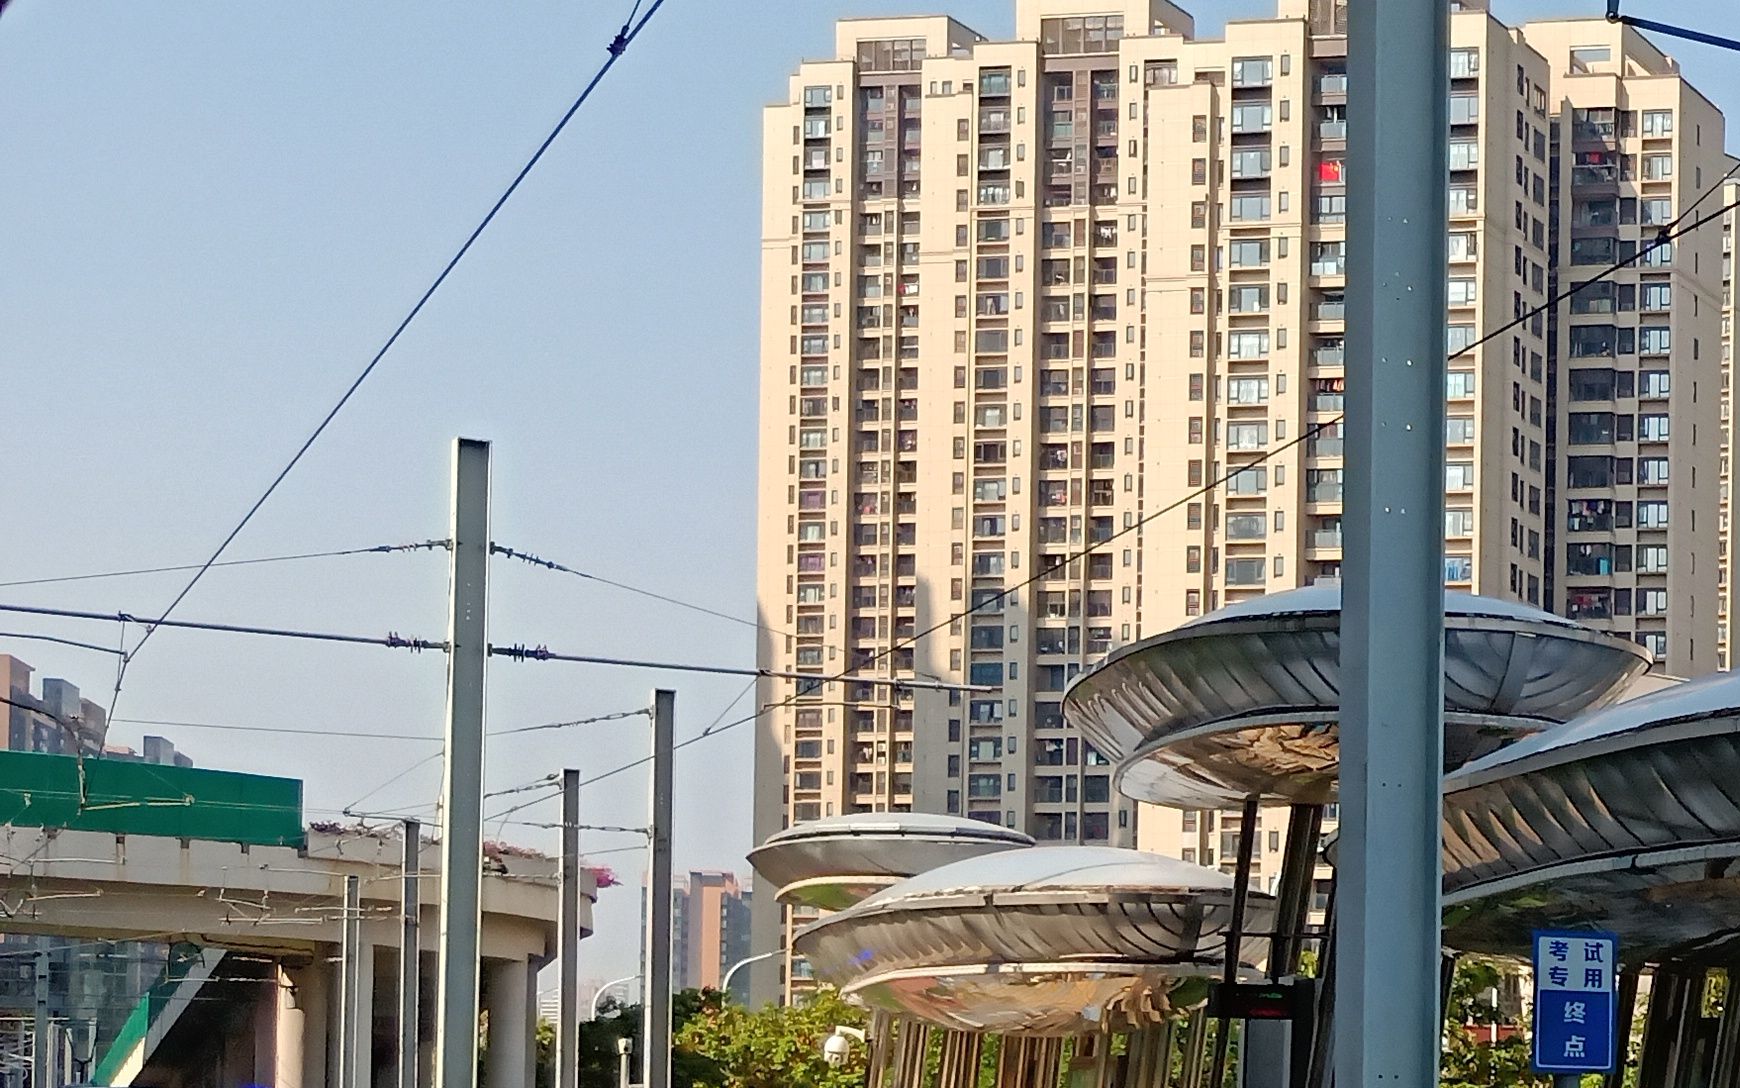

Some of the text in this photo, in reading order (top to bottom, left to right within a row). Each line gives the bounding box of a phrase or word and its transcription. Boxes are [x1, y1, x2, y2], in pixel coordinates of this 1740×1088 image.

[1549, 940, 1604, 963] 考试
[1548, 966, 1603, 989] 专用
[1563, 1001, 1587, 1058] 终点
